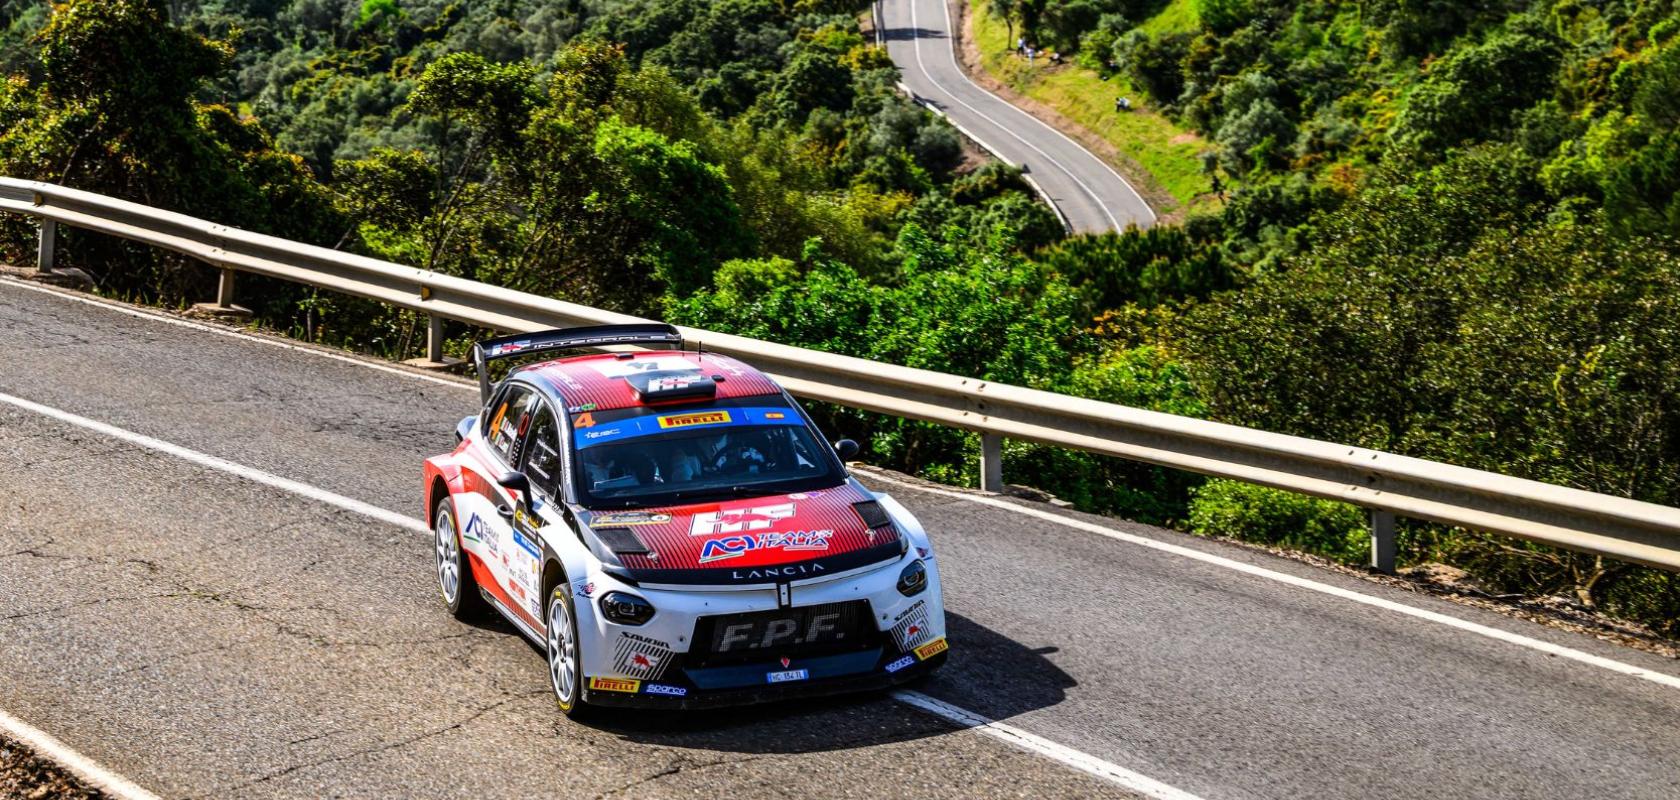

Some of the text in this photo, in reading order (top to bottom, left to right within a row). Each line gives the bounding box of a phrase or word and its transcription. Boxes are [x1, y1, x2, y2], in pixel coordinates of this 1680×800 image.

[489, 401, 509, 440] 4
[574, 412, 596, 429] 4
[666, 412, 725, 427] PIRELLI
[756, 530, 817, 541] TEAM
[757, 537, 828, 549] ITALIA
[700, 535, 756, 560] ACI
[732, 563, 826, 580] LANCIA
[718, 612, 846, 653] F.P.F.
[918, 638, 947, 658] PIRELLI
[594, 677, 637, 691] PIRELLI
[645, 683, 687, 696] sparco
